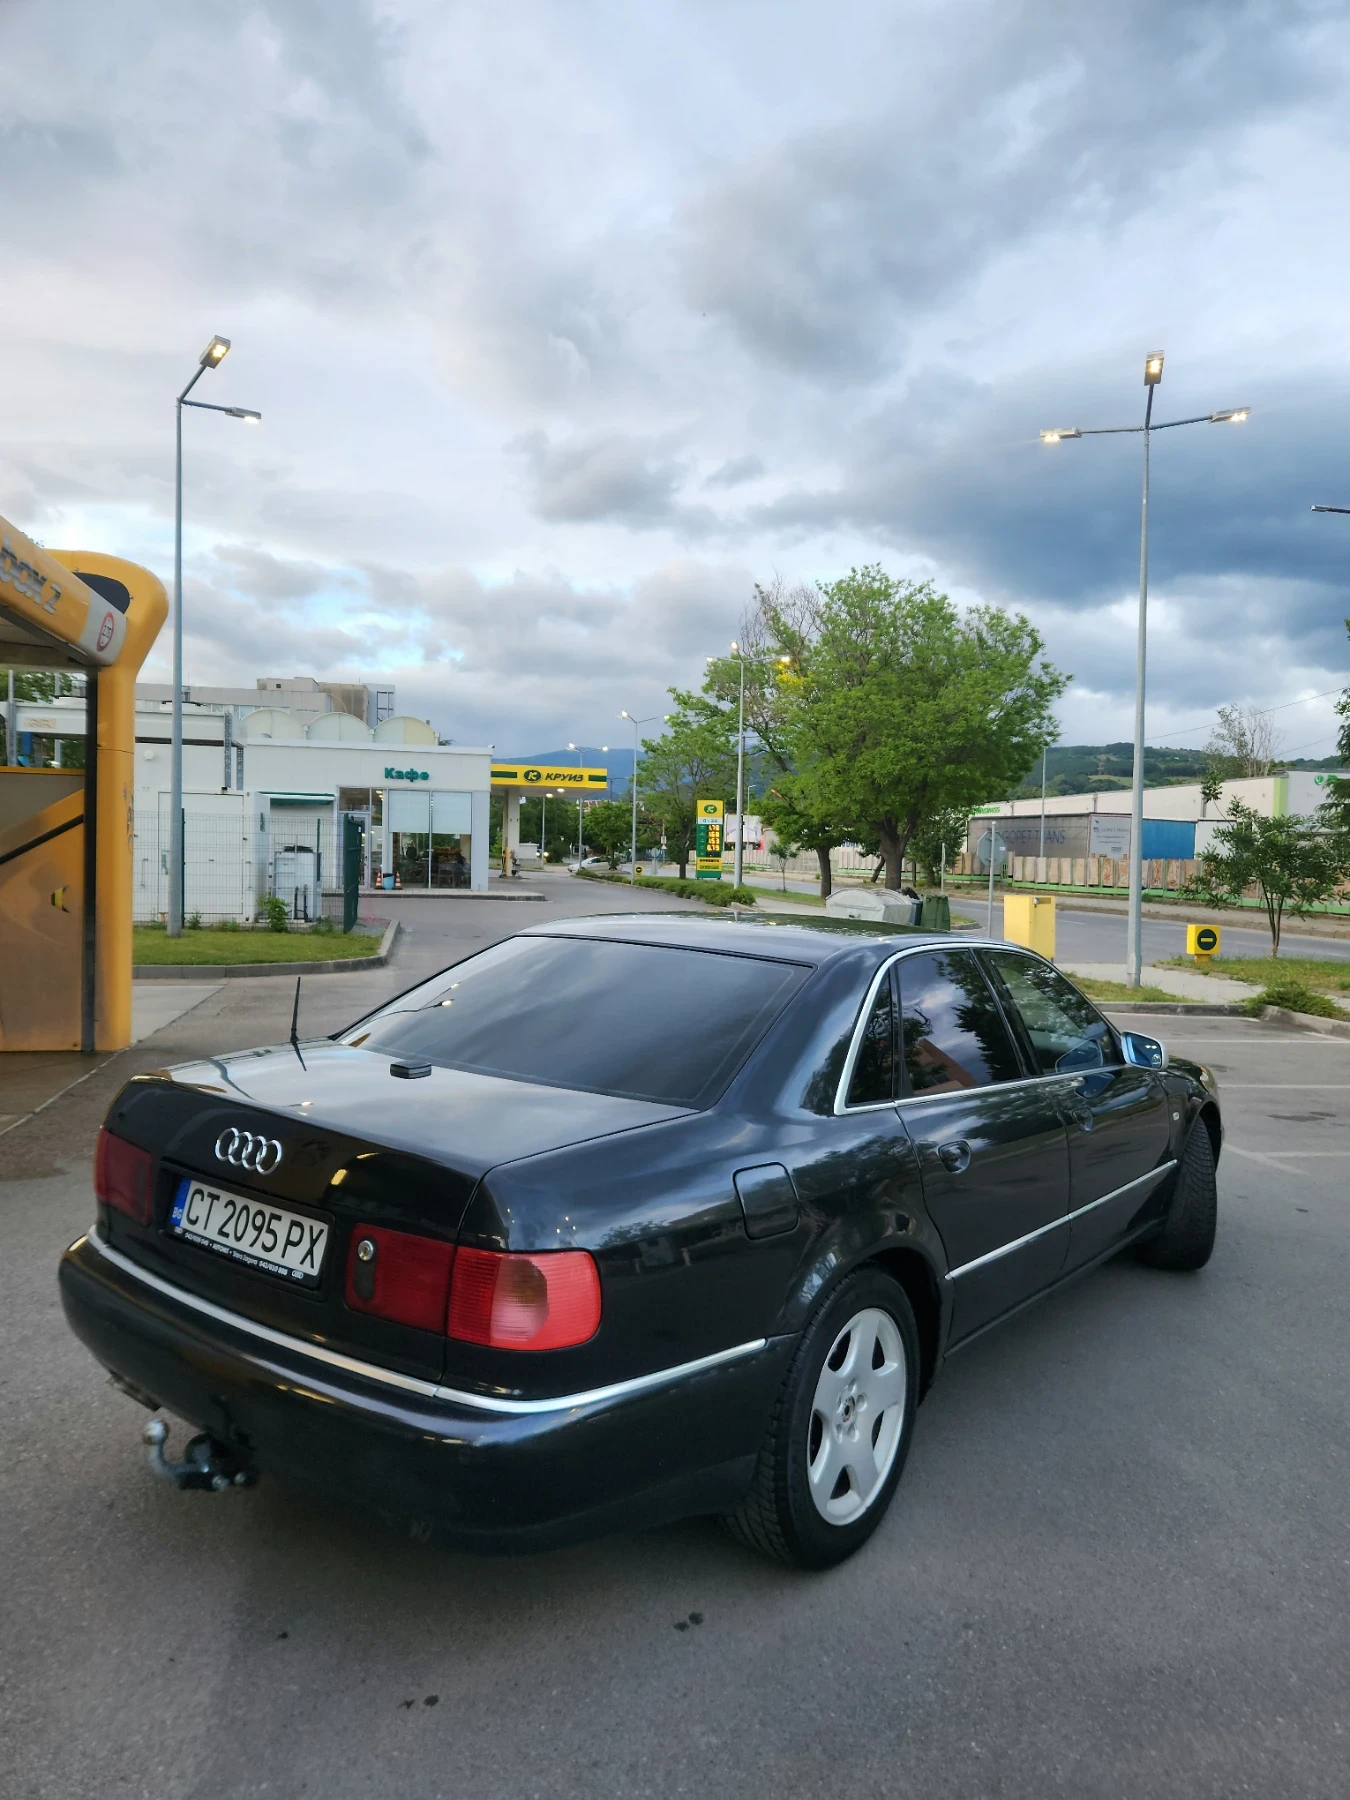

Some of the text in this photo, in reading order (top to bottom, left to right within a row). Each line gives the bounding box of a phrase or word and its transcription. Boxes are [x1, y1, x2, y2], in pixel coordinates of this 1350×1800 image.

[42, 582, 62, 615] 2
[384, 767, 430, 783] Кафе
[545, 772, 584, 782] КРУИЗ
[172, 1206, 182, 1219] BG
[186, 1188, 325, 1269] CT 2095 PX
